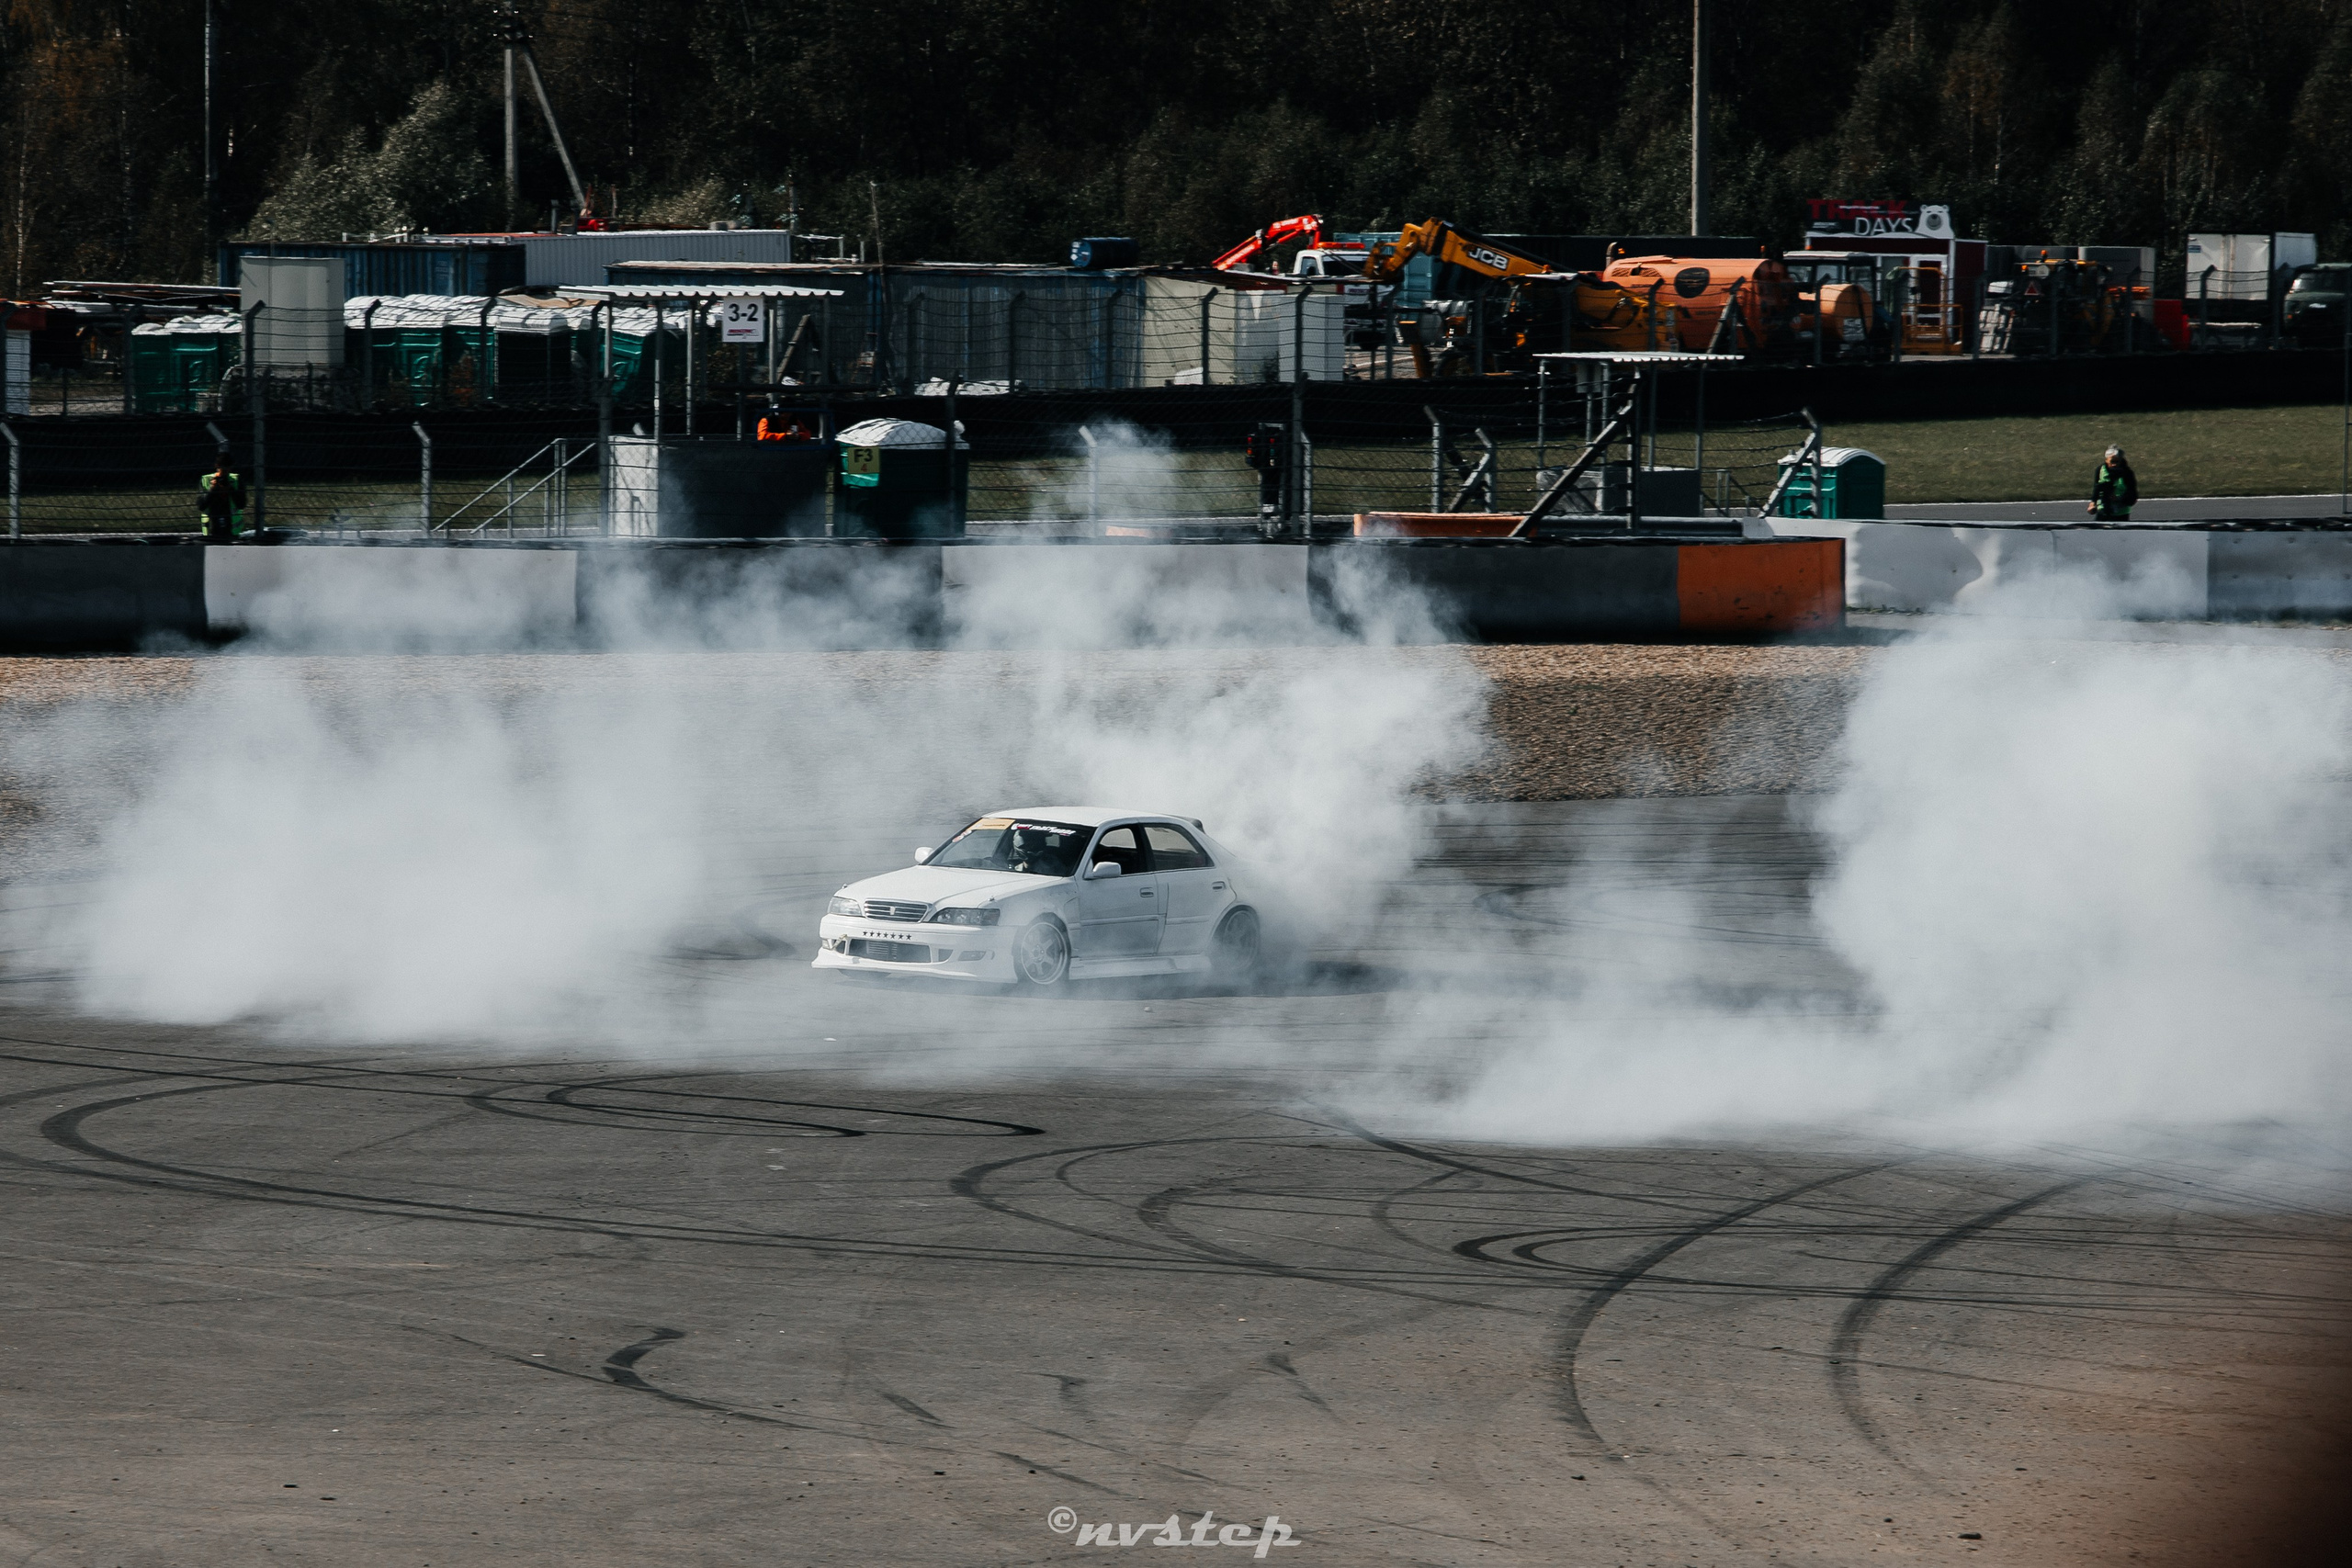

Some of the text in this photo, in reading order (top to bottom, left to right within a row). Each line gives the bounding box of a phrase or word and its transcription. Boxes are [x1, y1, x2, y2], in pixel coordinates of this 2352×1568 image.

[1807, 199, 1908, 220] TRACK
[1854, 217, 1914, 236] DAYS
[1468, 247, 1510, 270] JCB
[728, 303, 759, 321] 3-2
[854, 448, 874, 463] F3
